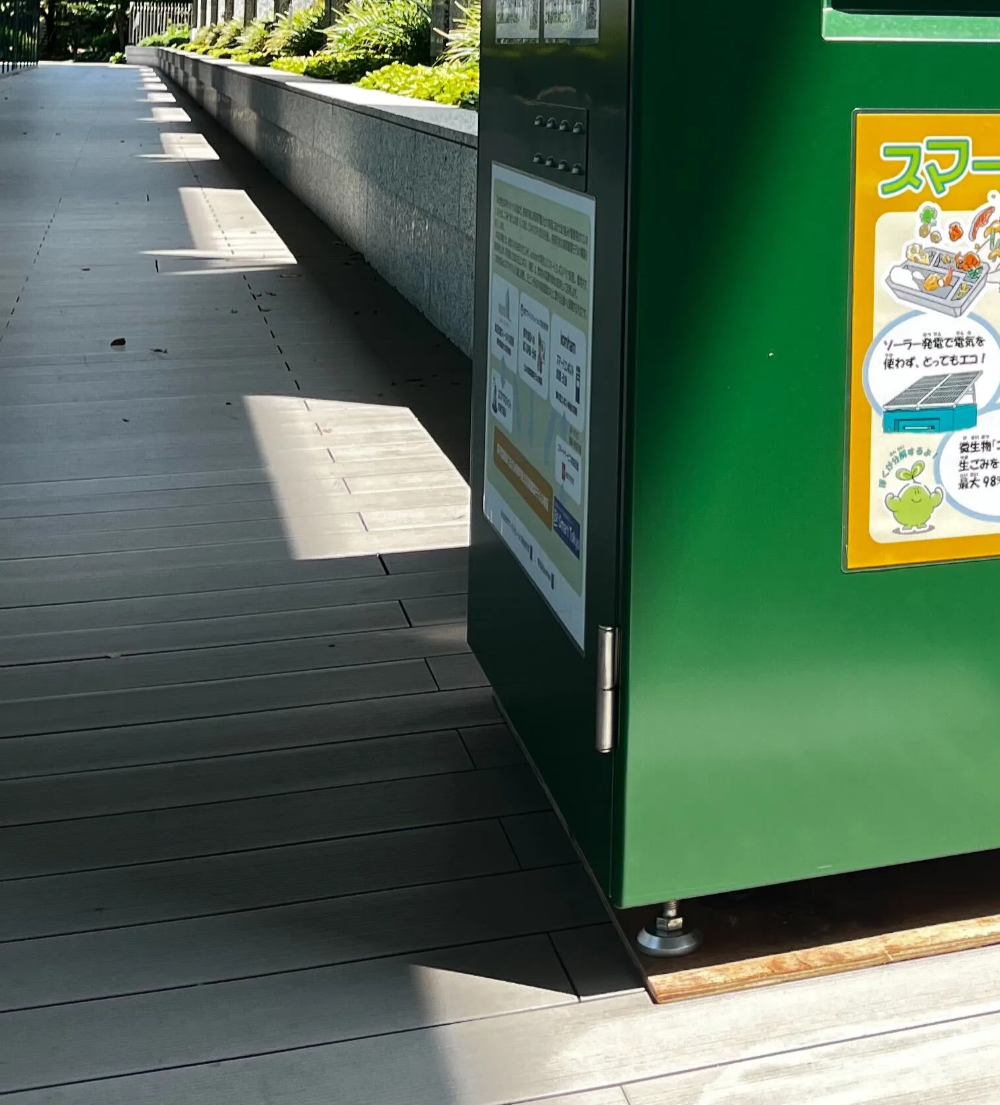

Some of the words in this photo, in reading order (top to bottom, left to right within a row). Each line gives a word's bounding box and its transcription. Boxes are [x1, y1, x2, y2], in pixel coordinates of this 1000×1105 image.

[883, 336, 986, 351] ソーラー発電で電気を
[883, 353, 986, 370] 使わず、とってもエコ！
